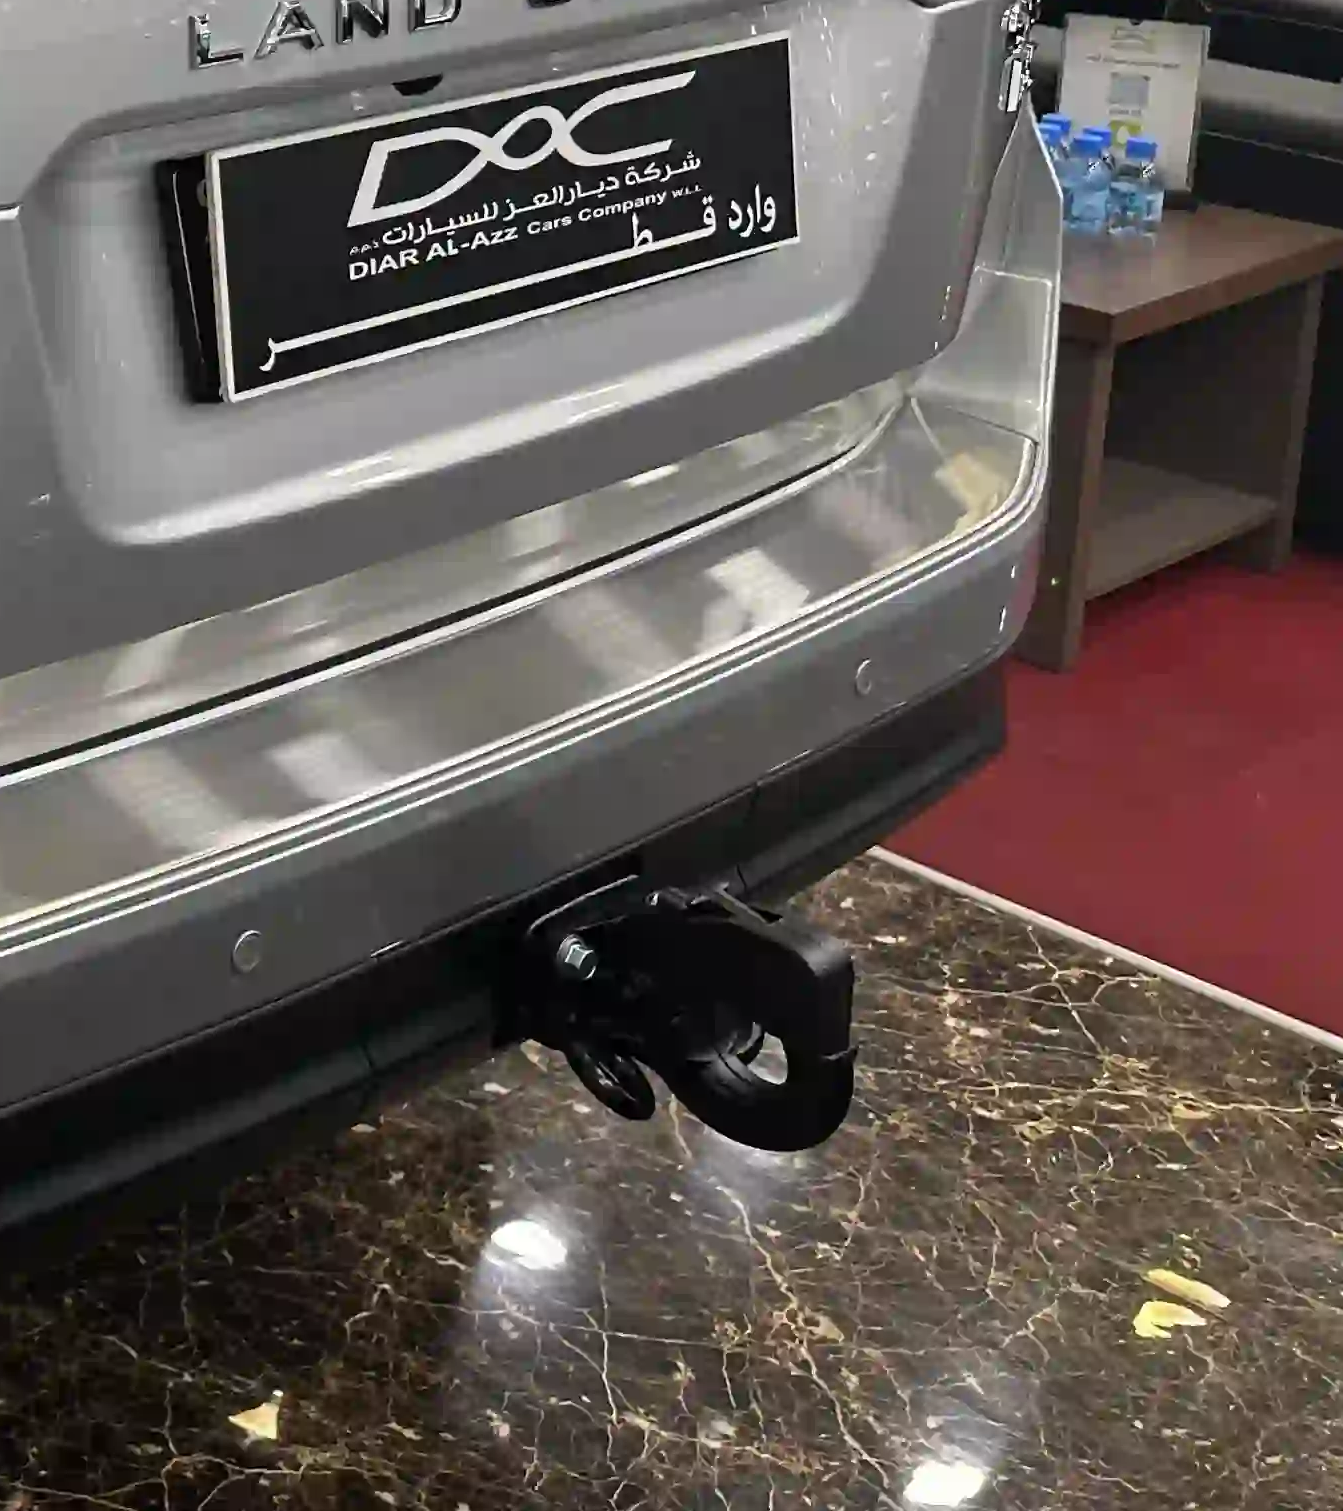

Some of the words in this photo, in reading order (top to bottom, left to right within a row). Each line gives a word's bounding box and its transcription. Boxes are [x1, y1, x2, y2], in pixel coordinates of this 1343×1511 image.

[624, 150, 702, 186] شركة
[348, 247, 420, 281] DIAR
[526, 213, 573, 236] Cars
[577, 188, 667, 223] Company
[381, 200, 499, 246] للسيارات
[727, 182, 777, 239] وارد
